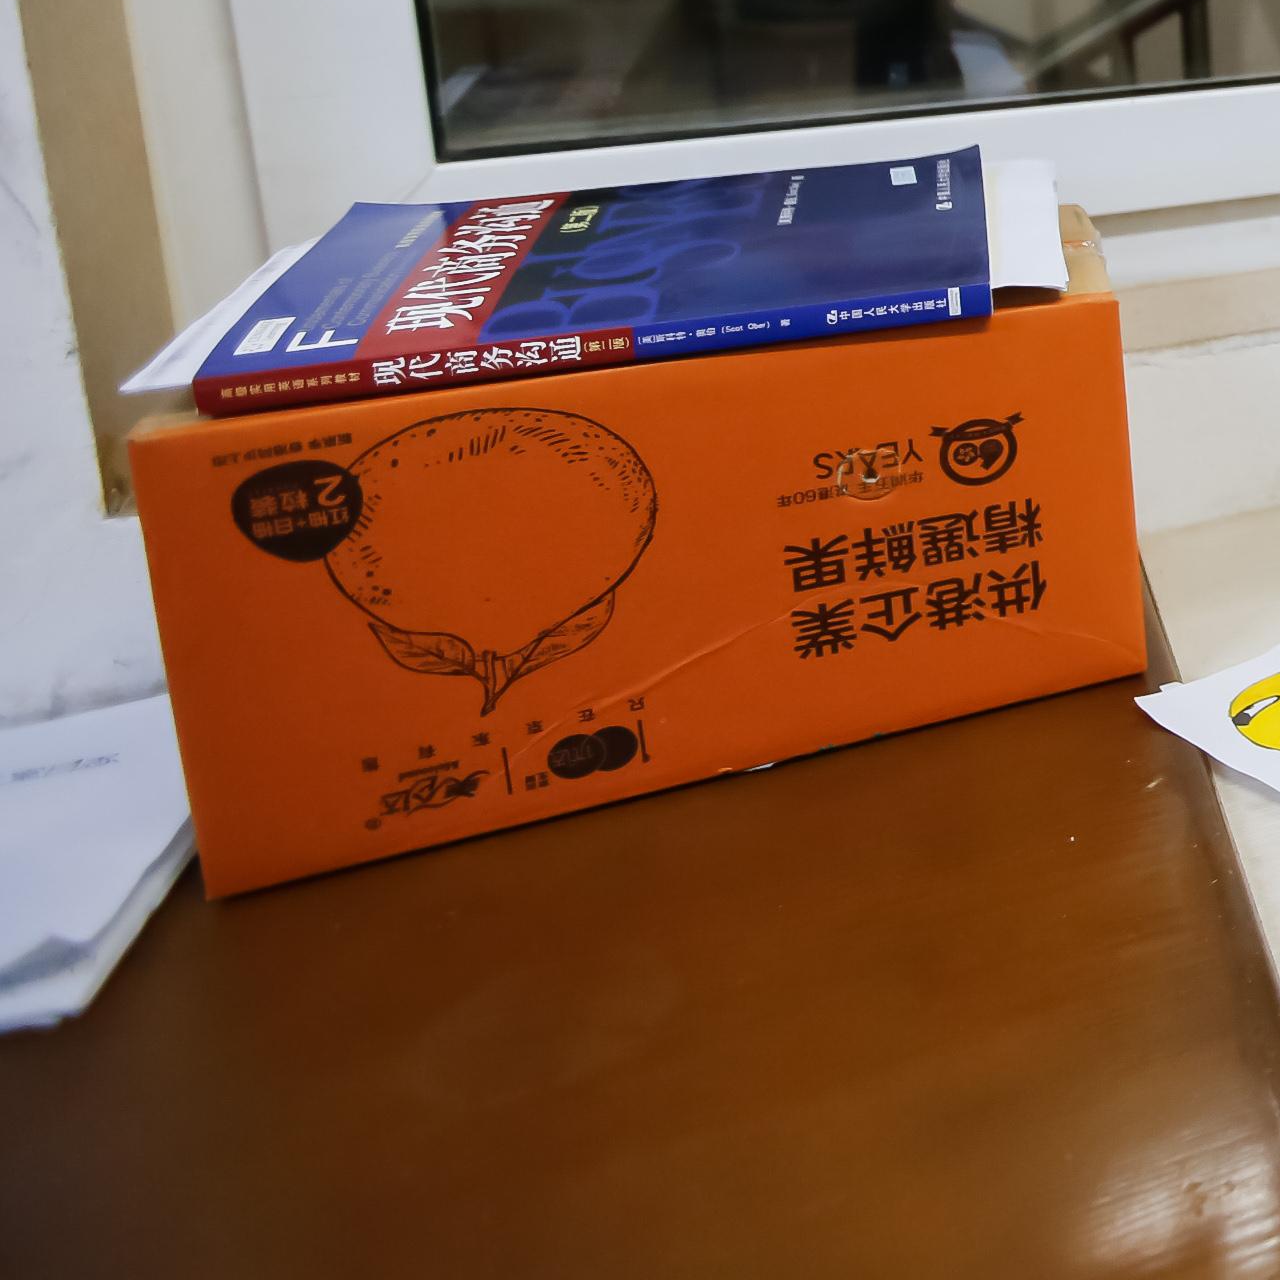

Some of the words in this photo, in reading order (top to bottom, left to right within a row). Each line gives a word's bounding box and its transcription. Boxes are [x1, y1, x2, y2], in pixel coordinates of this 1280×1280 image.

[385, 199, 556, 335] 现代商务沟通
[838, 297, 947, 321] 中国人民大学出版社
[371, 335, 583, 387] 现代商务沟通
[812, 437, 926, 480] YEARS
[782, 497, 1044, 593] 精選鮮果
[789, 560, 1048, 661] 供港企業
